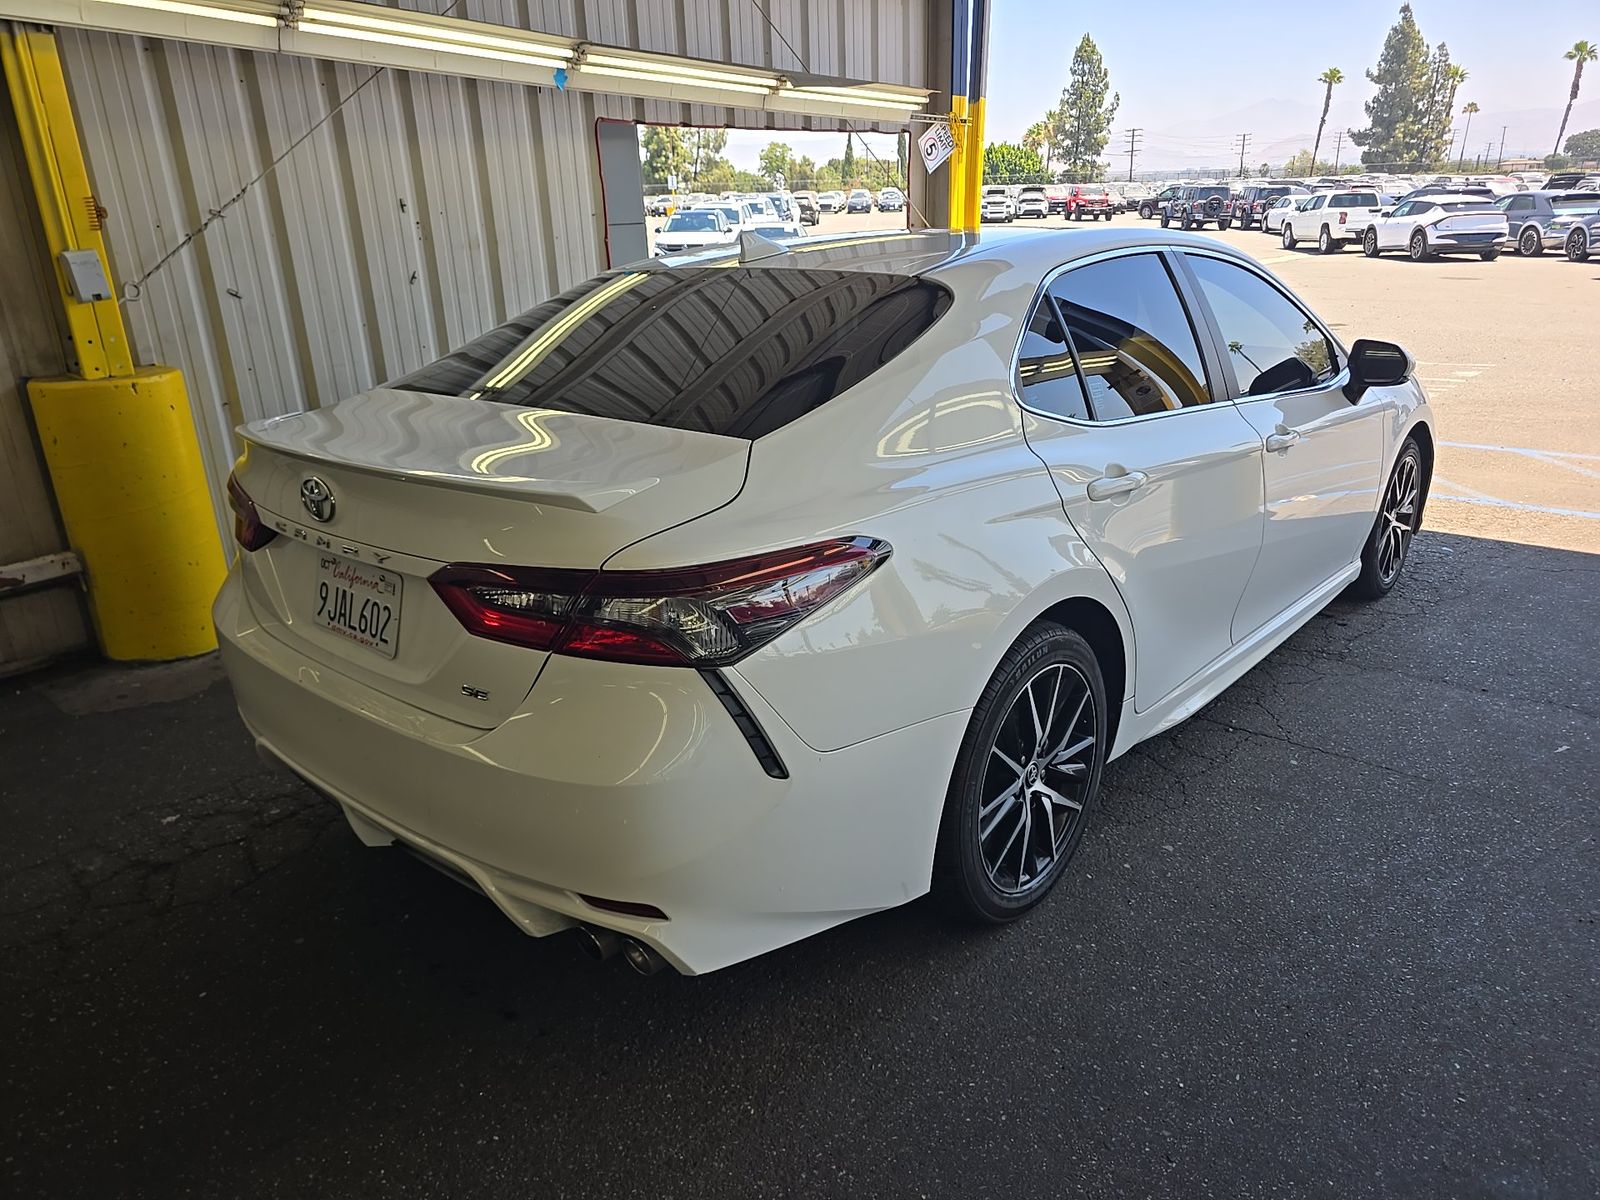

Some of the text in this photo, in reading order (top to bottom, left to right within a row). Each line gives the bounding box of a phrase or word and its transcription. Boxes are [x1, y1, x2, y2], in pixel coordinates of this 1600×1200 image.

[925, 142, 937, 156] 5
[934, 127, 948, 151] LIMIT
[333, 561, 384, 594] California
[317, 580, 392, 645] 9JAL602
[461, 684, 490, 701] SE
